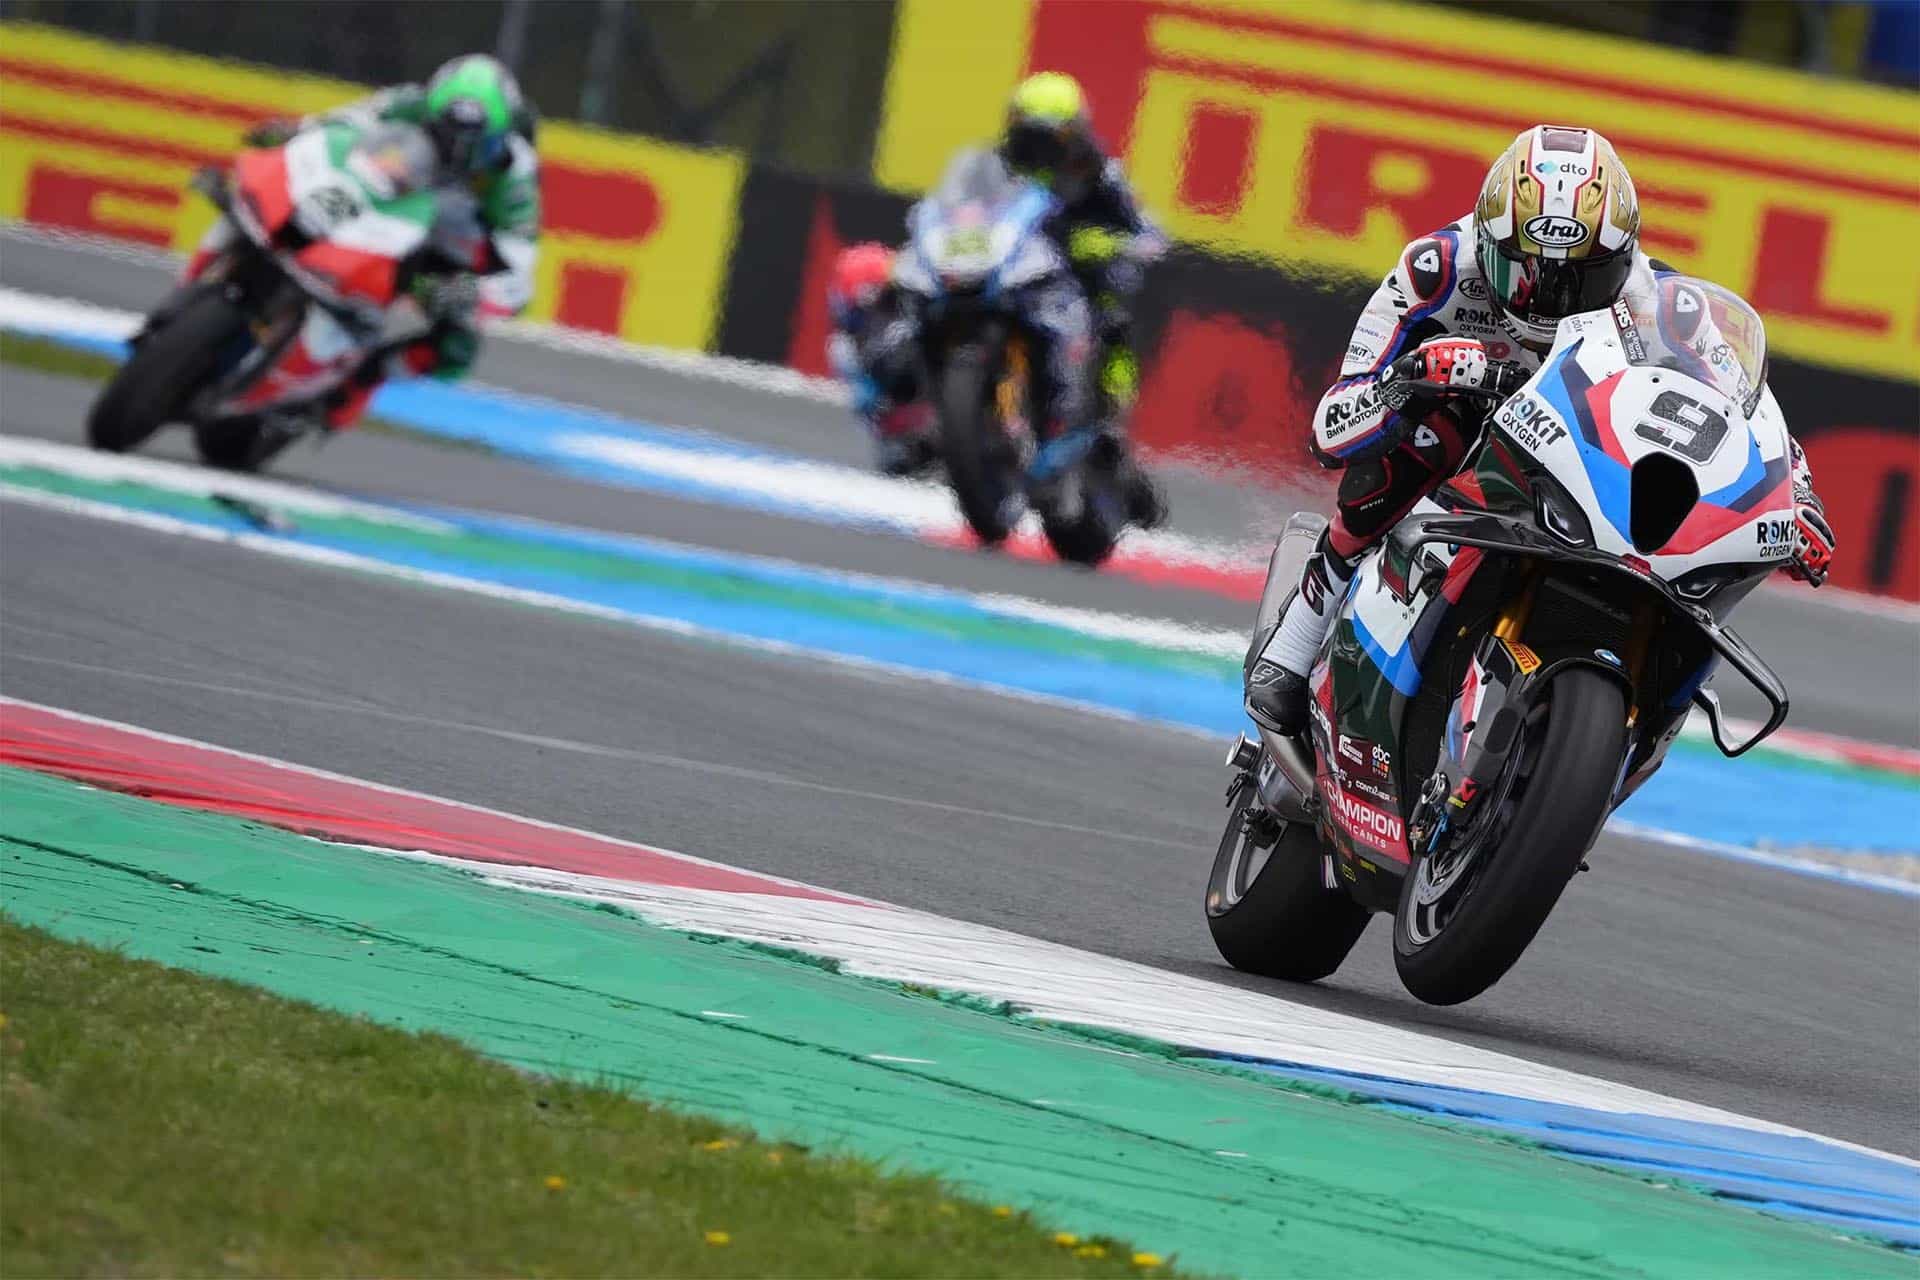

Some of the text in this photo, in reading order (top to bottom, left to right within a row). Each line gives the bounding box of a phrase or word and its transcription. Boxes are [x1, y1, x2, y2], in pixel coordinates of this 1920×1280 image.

[1559, 162, 1588, 176] dto
[1529, 218, 1580, 238] Arai
[1454, 307, 1498, 326] ROKi
[1460, 323, 1497, 336] OXYGEN
[1326, 384, 1381, 428] ROKi
[1505, 391, 1567, 446] ROKiT
[1326, 424, 1346, 439] BMW
[1501, 412, 1541, 451] OXYGEN
[1633, 390, 1730, 466] 9
[1757, 520, 1794, 545] ROKi
[1326, 782, 1401, 842] CHAMPION
